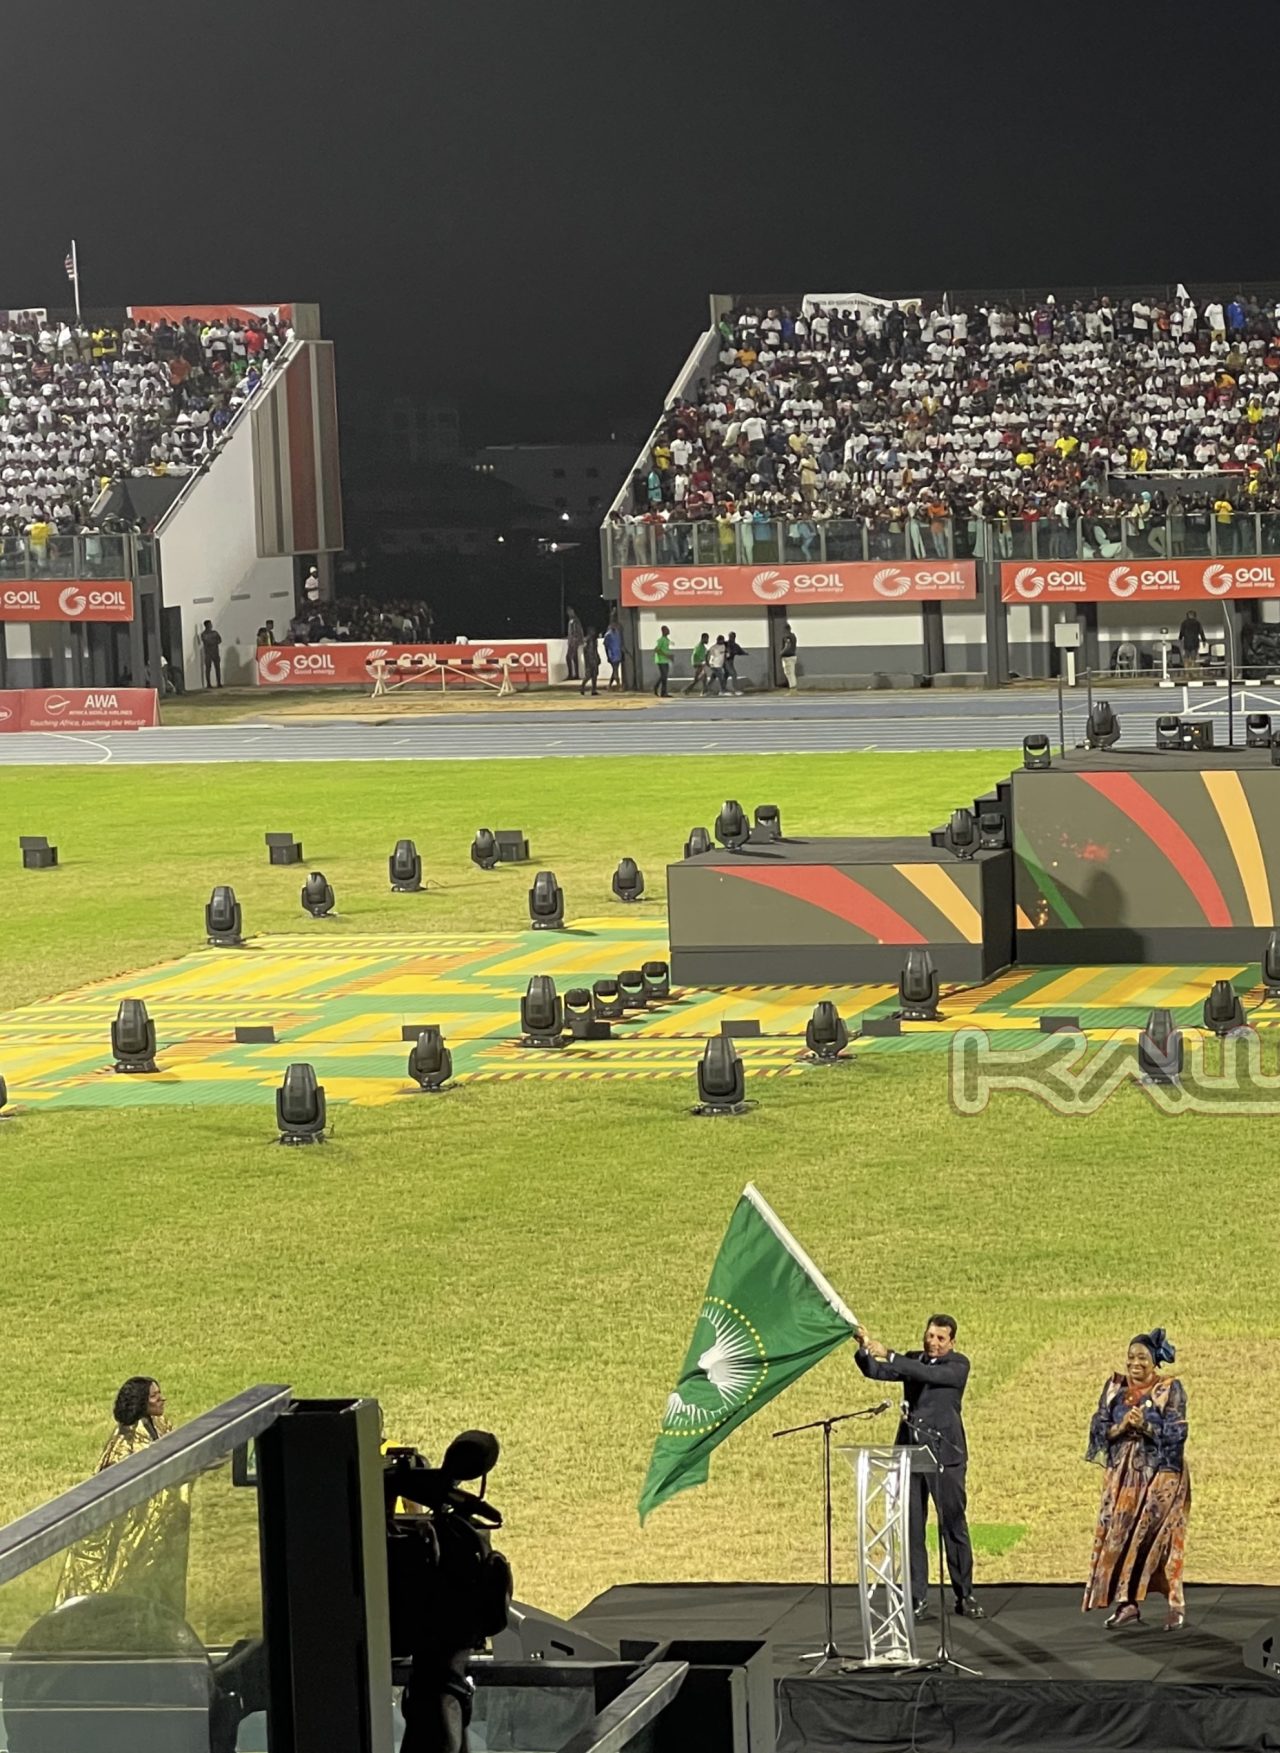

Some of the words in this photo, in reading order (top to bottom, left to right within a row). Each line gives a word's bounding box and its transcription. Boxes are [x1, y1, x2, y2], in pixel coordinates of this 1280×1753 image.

[793, 574, 844, 587] GOIL
[915, 571, 965, 584] GOIL
[1047, 571, 1086, 585] GOIL
[1141, 570, 1180, 584] GOIL
[1236, 567, 1274, 582] GOIL
[673, 577, 723, 590] GOIL
[4, 591, 40, 604] GOIL
[89, 591, 125, 604] GOIL
[294, 654, 335, 668] GOIL
[84, 694, 118, 708] AWA
